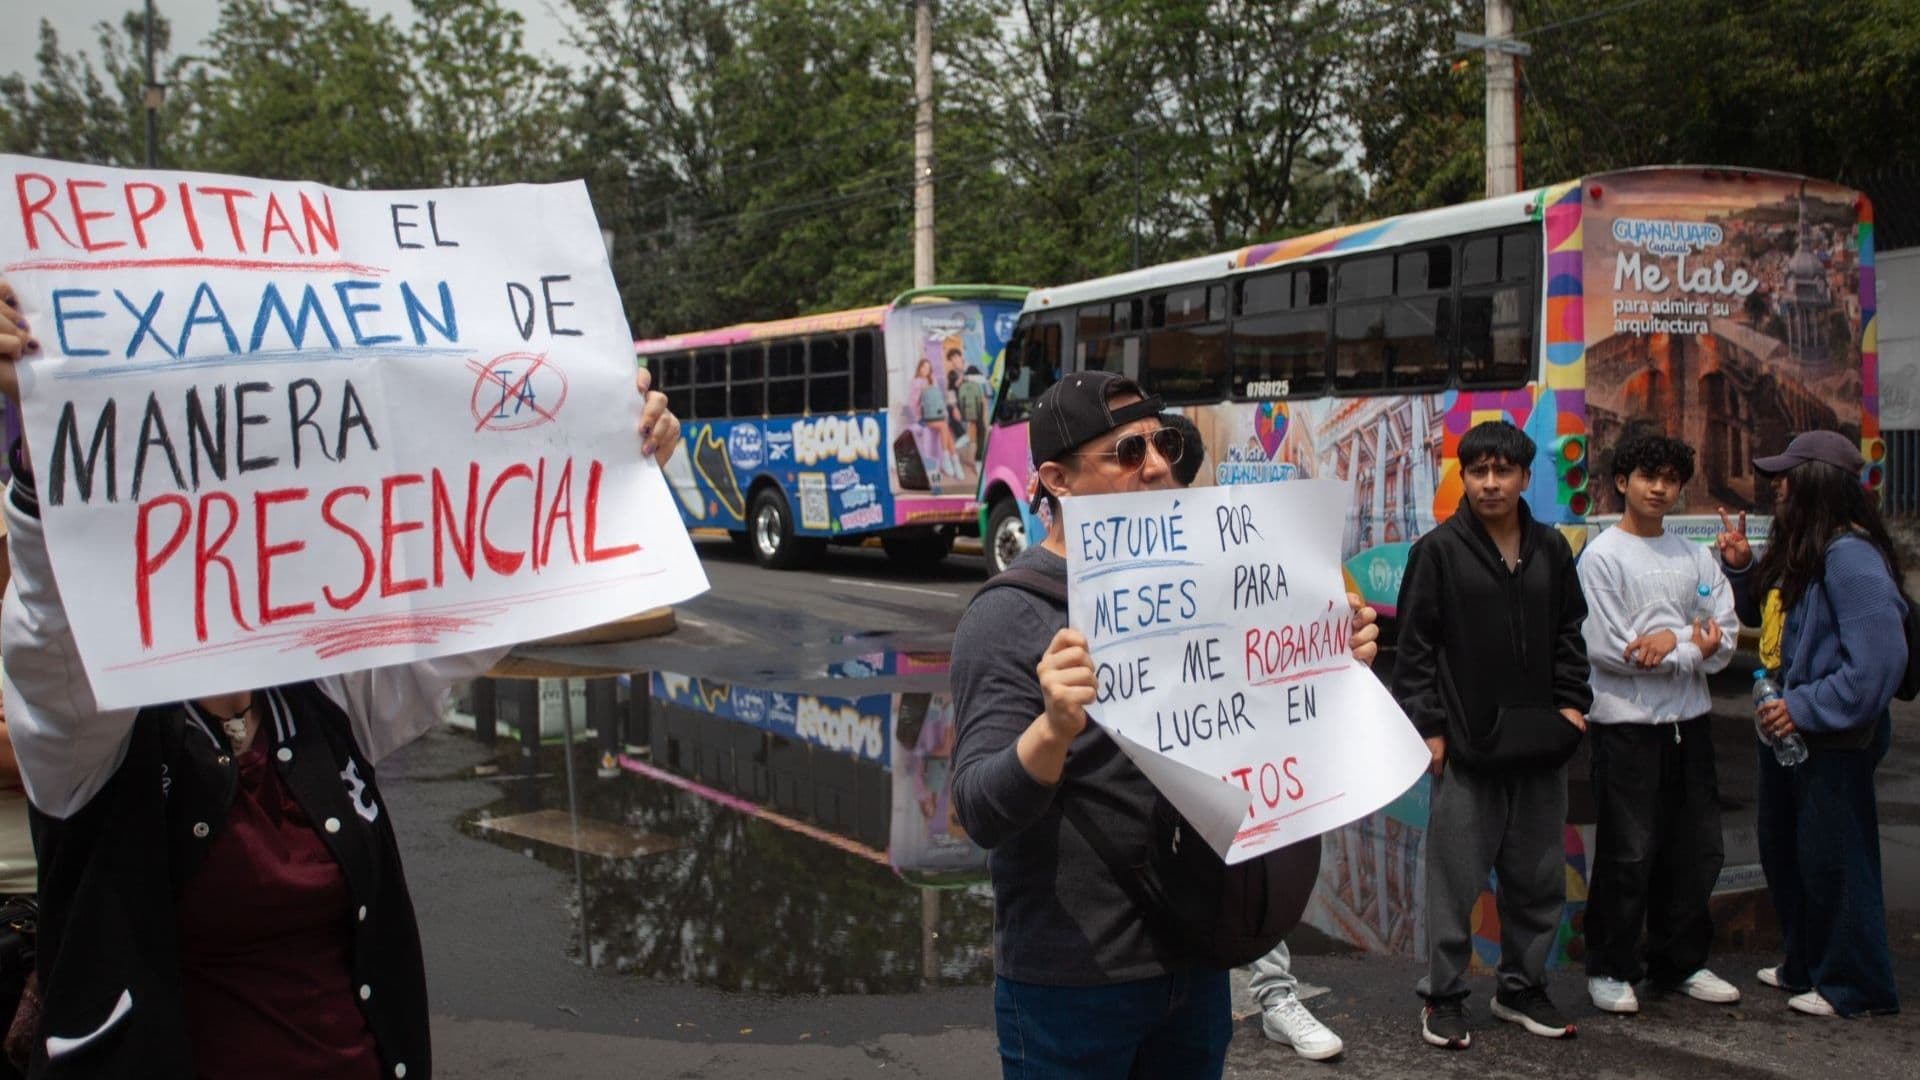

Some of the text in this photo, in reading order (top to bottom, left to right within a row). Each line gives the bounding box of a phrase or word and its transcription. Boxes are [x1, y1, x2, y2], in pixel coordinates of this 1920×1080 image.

[16, 172, 459, 255] REPITAN EL
[1612, 218, 1723, 246] GUANAJUATO
[1614, 251, 1670, 293] Me
[1648, 241, 1690, 256] Capital
[52, 275, 582, 359] EXAMEN DE
[1613, 298, 1729, 317] para admirar su
[1614, 316, 1708, 337] arquitectura
[494, 369, 537, 419] IA
[1246, 380, 1289, 398] 0760125
[49, 378, 378, 506] MANERA
[792, 415, 881, 465] ESCOLAR
[136, 457, 641, 651] PRESENCIAL
[1081, 500, 1264, 561] ESTUDIÉ POR
[1094, 563, 1288, 639] MESES PARA
[1095, 600, 1349, 704] QUE ME ROBARÁN
[1157, 684, 1316, 752] LUGAR EN
